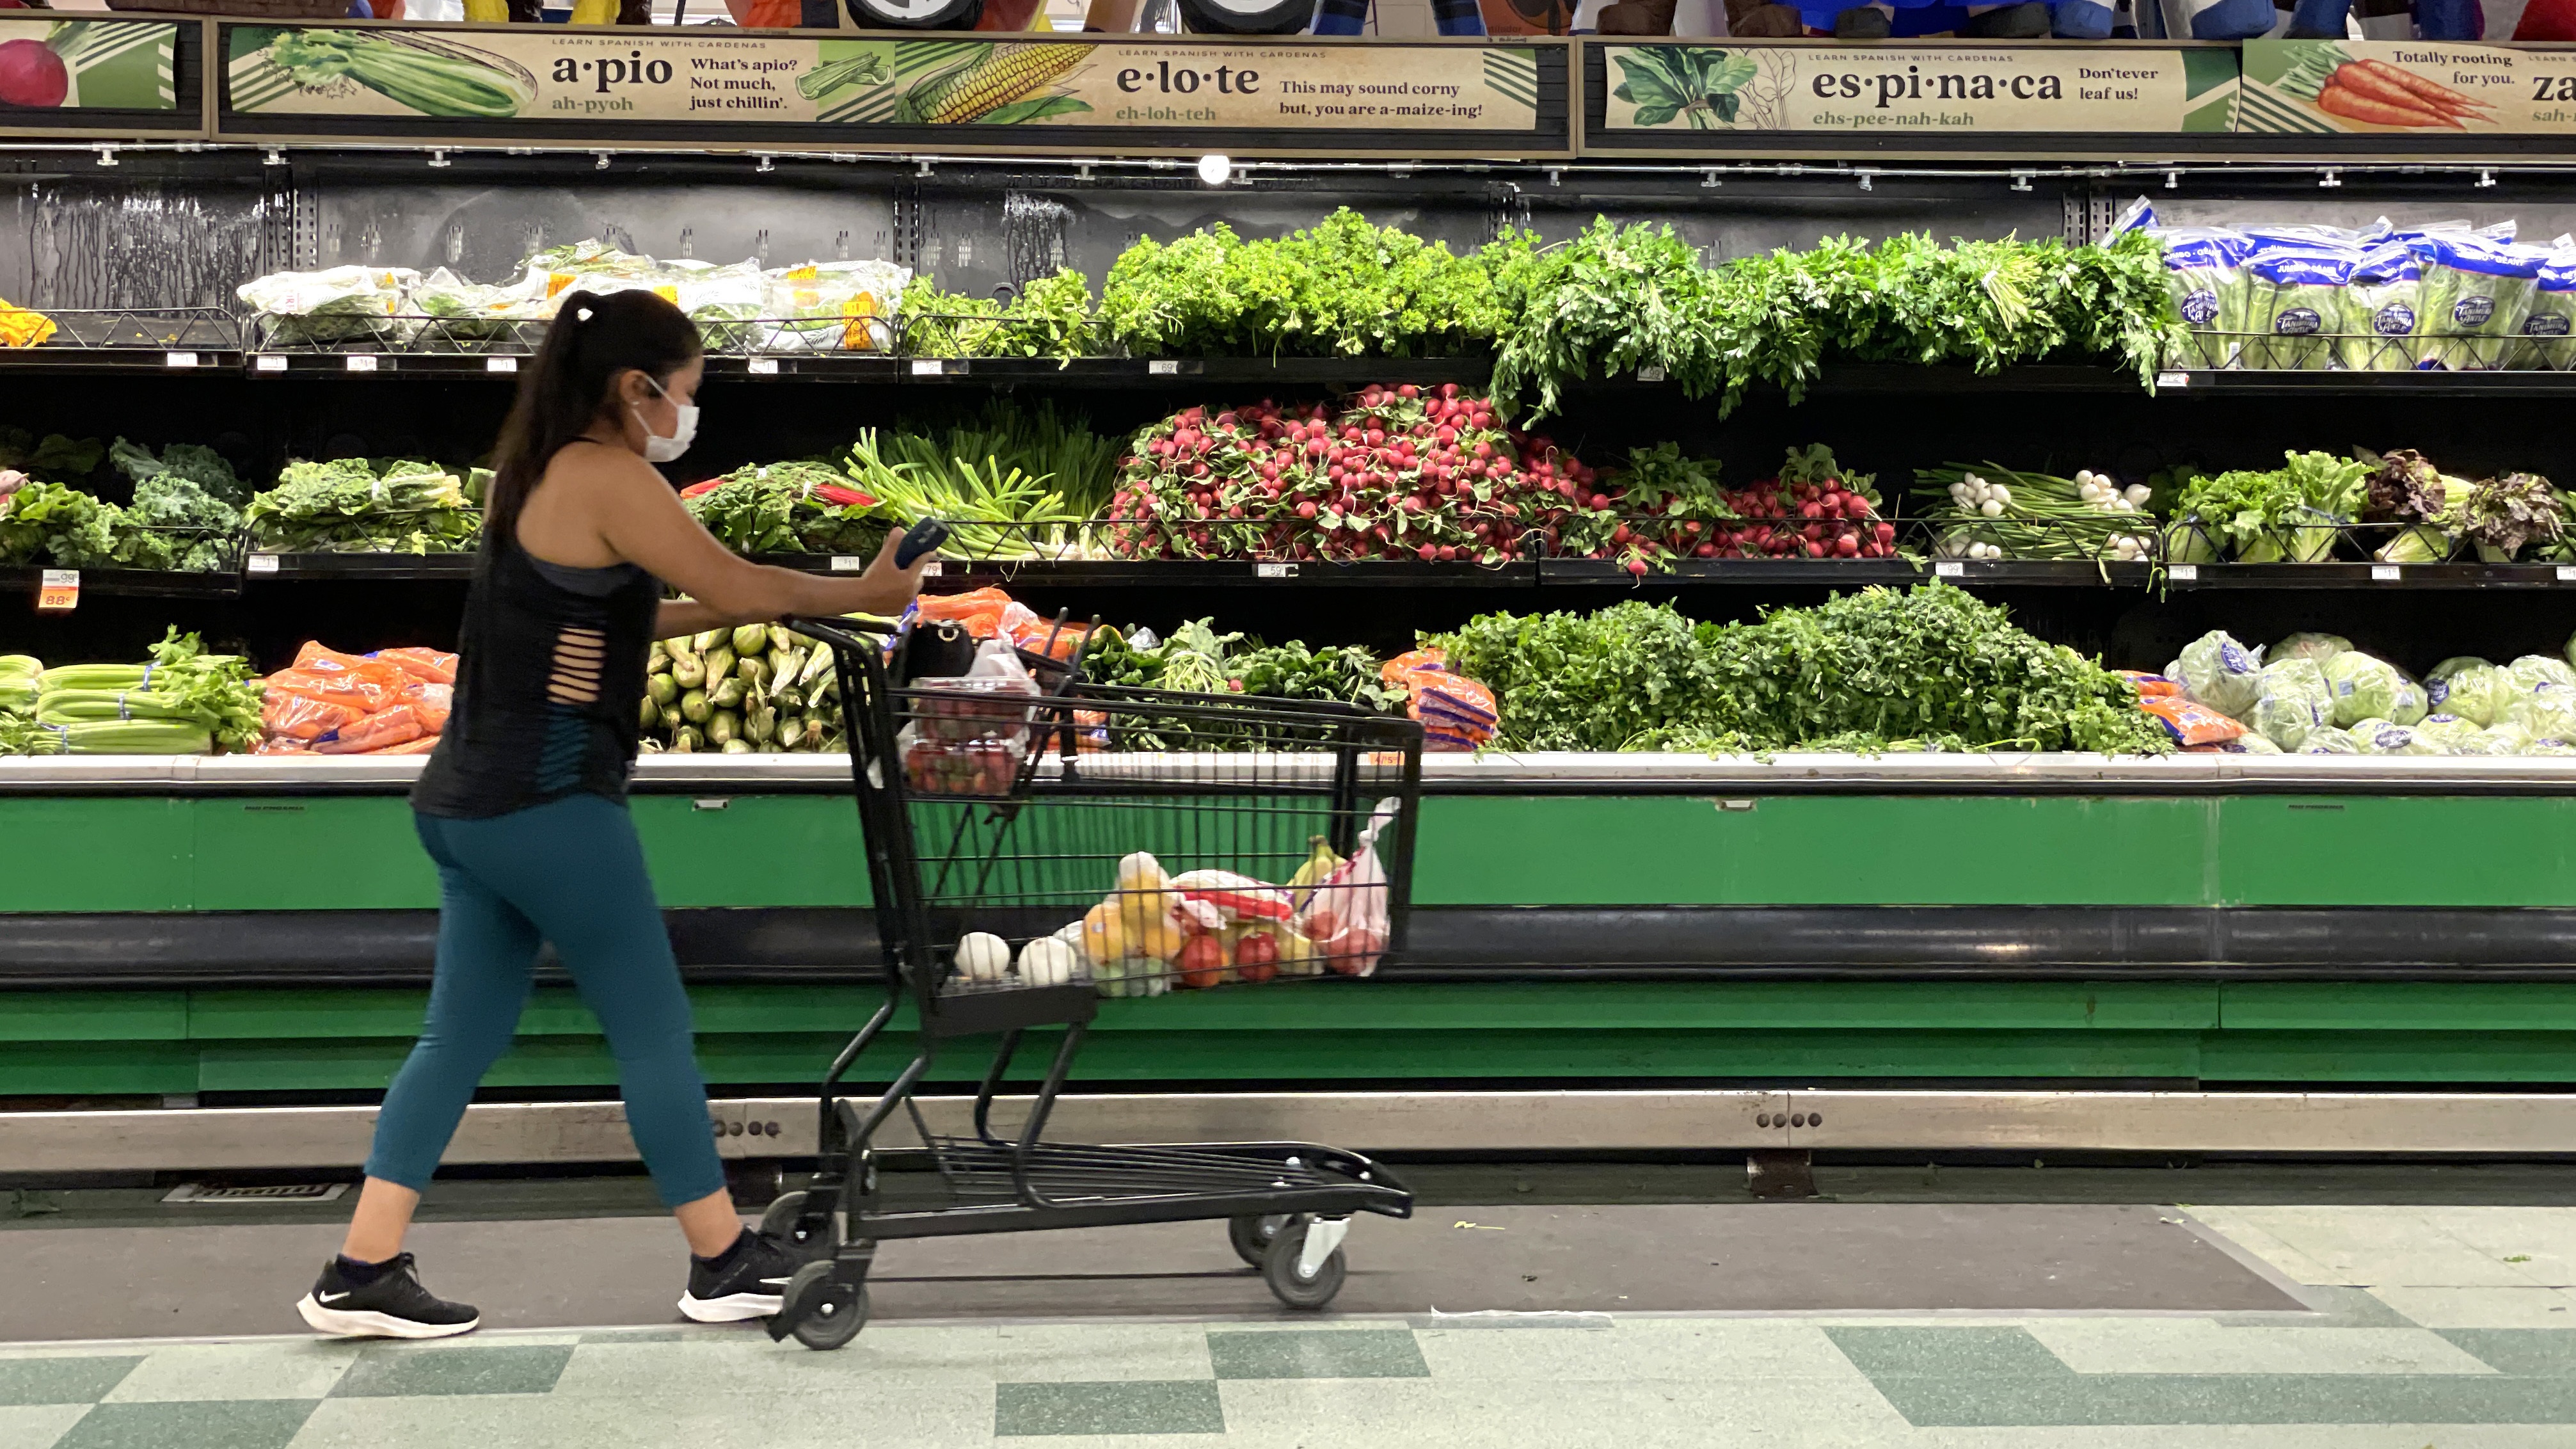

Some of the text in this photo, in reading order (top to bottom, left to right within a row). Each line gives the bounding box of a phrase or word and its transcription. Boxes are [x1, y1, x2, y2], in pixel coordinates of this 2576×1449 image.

[690, 58, 797, 74] What's apio?
[2392, 51, 2513, 68] Totally rooting
[690, 76, 775, 92] Not much,
[2453, 71, 2515, 88] for you.
[1279, 81, 1460, 99] This may sound corny
[2079, 86, 2138, 100] leaf us!
[552, 96, 633, 114] ah-pyoh
[688, 95, 788, 111] just chillin'.
[1280, 102, 1483, 119] but, you are a-maize-ing!
[1115, 106, 1216, 123] eh-loh-teh
[1813, 111, 1974, 129] ehs-pee-nah-kah
